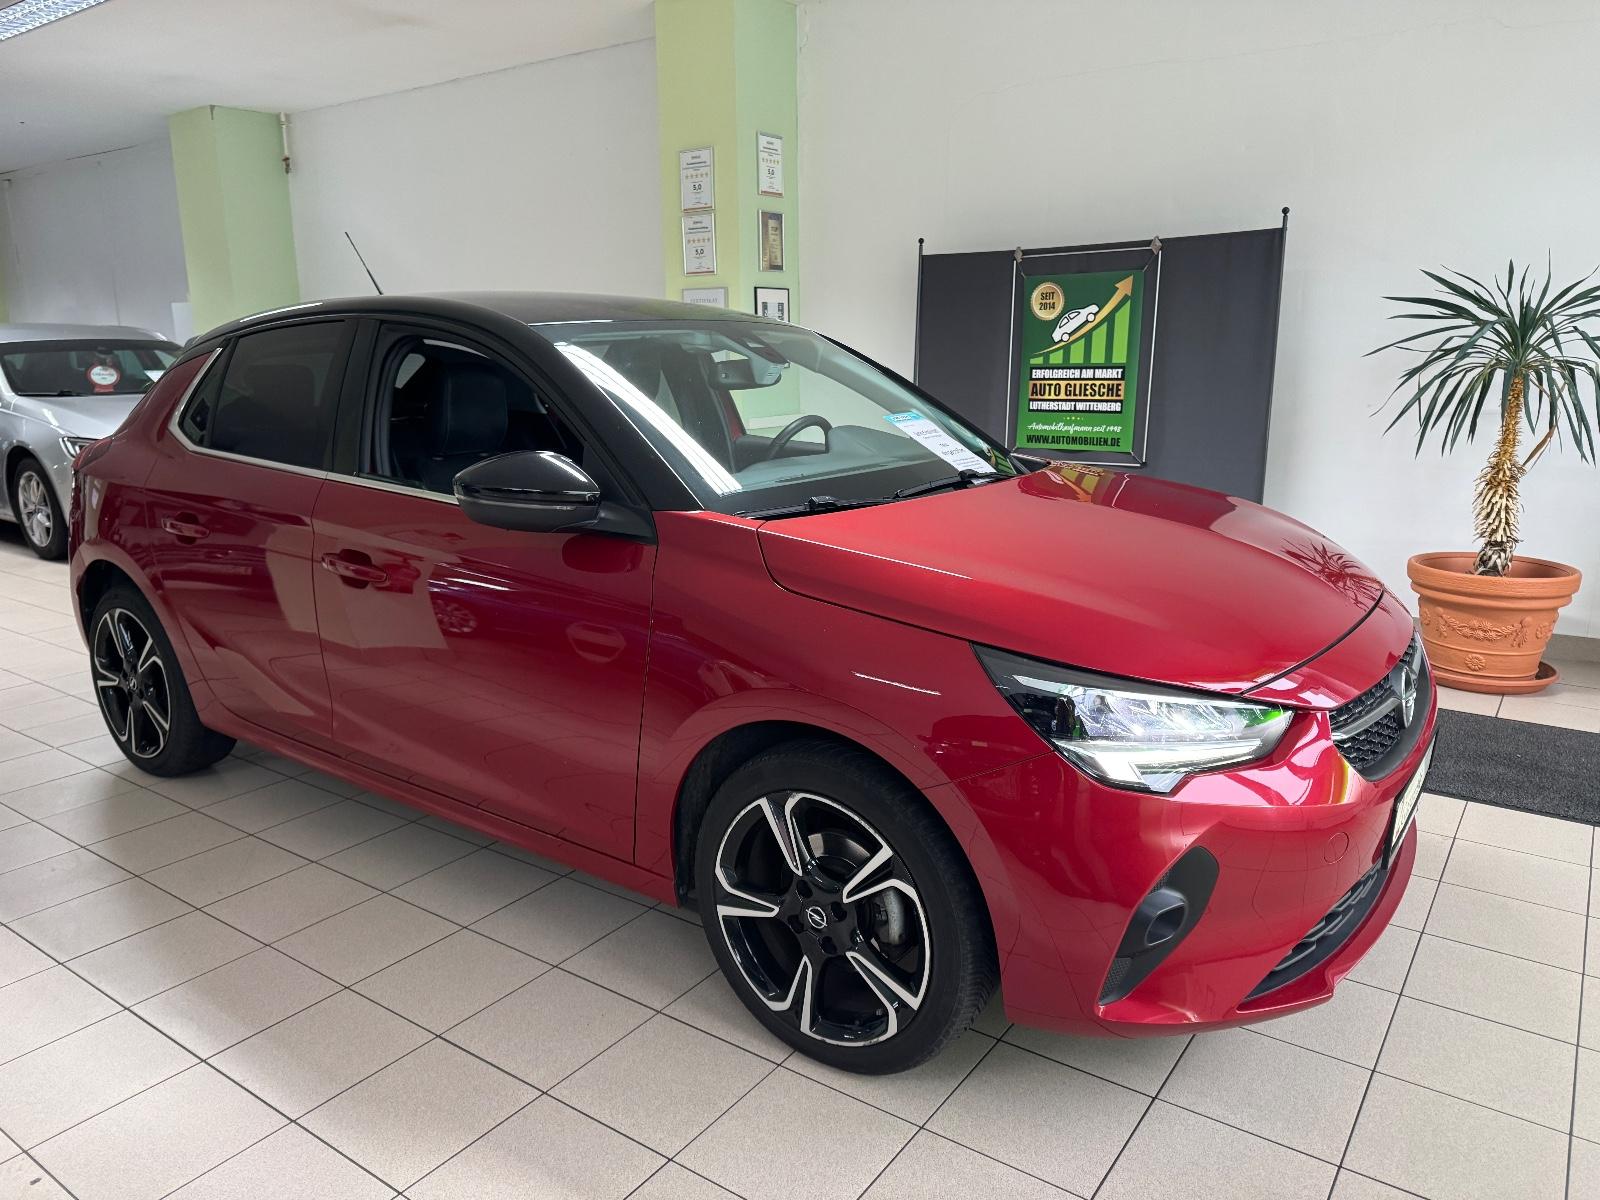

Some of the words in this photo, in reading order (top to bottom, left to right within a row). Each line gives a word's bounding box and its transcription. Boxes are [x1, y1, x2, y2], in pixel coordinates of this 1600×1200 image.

[692, 183, 702, 191] 5,0
[695, 248, 705, 256] 5,0
[1040, 291, 1055, 301] SEIT
[1039, 301, 1056, 311] 2014
[1032, 368, 1080, 379] ERFOLGREICH
[1080, 368, 1094, 379] AM
[1094, 368, 1123, 379] MARKT
[1030, 382, 1061, 397] AUTO
[1064, 382, 1122, 398] GLIESCHE
[1029, 401, 1075, 411] LUTHERSTADT
[1075, 401, 1122, 412] WITTENBERG
[1092, 424, 1106, 433] seit
[1026, 435, 1121, 447] WWW.AUTOMOBILIEN.DE
